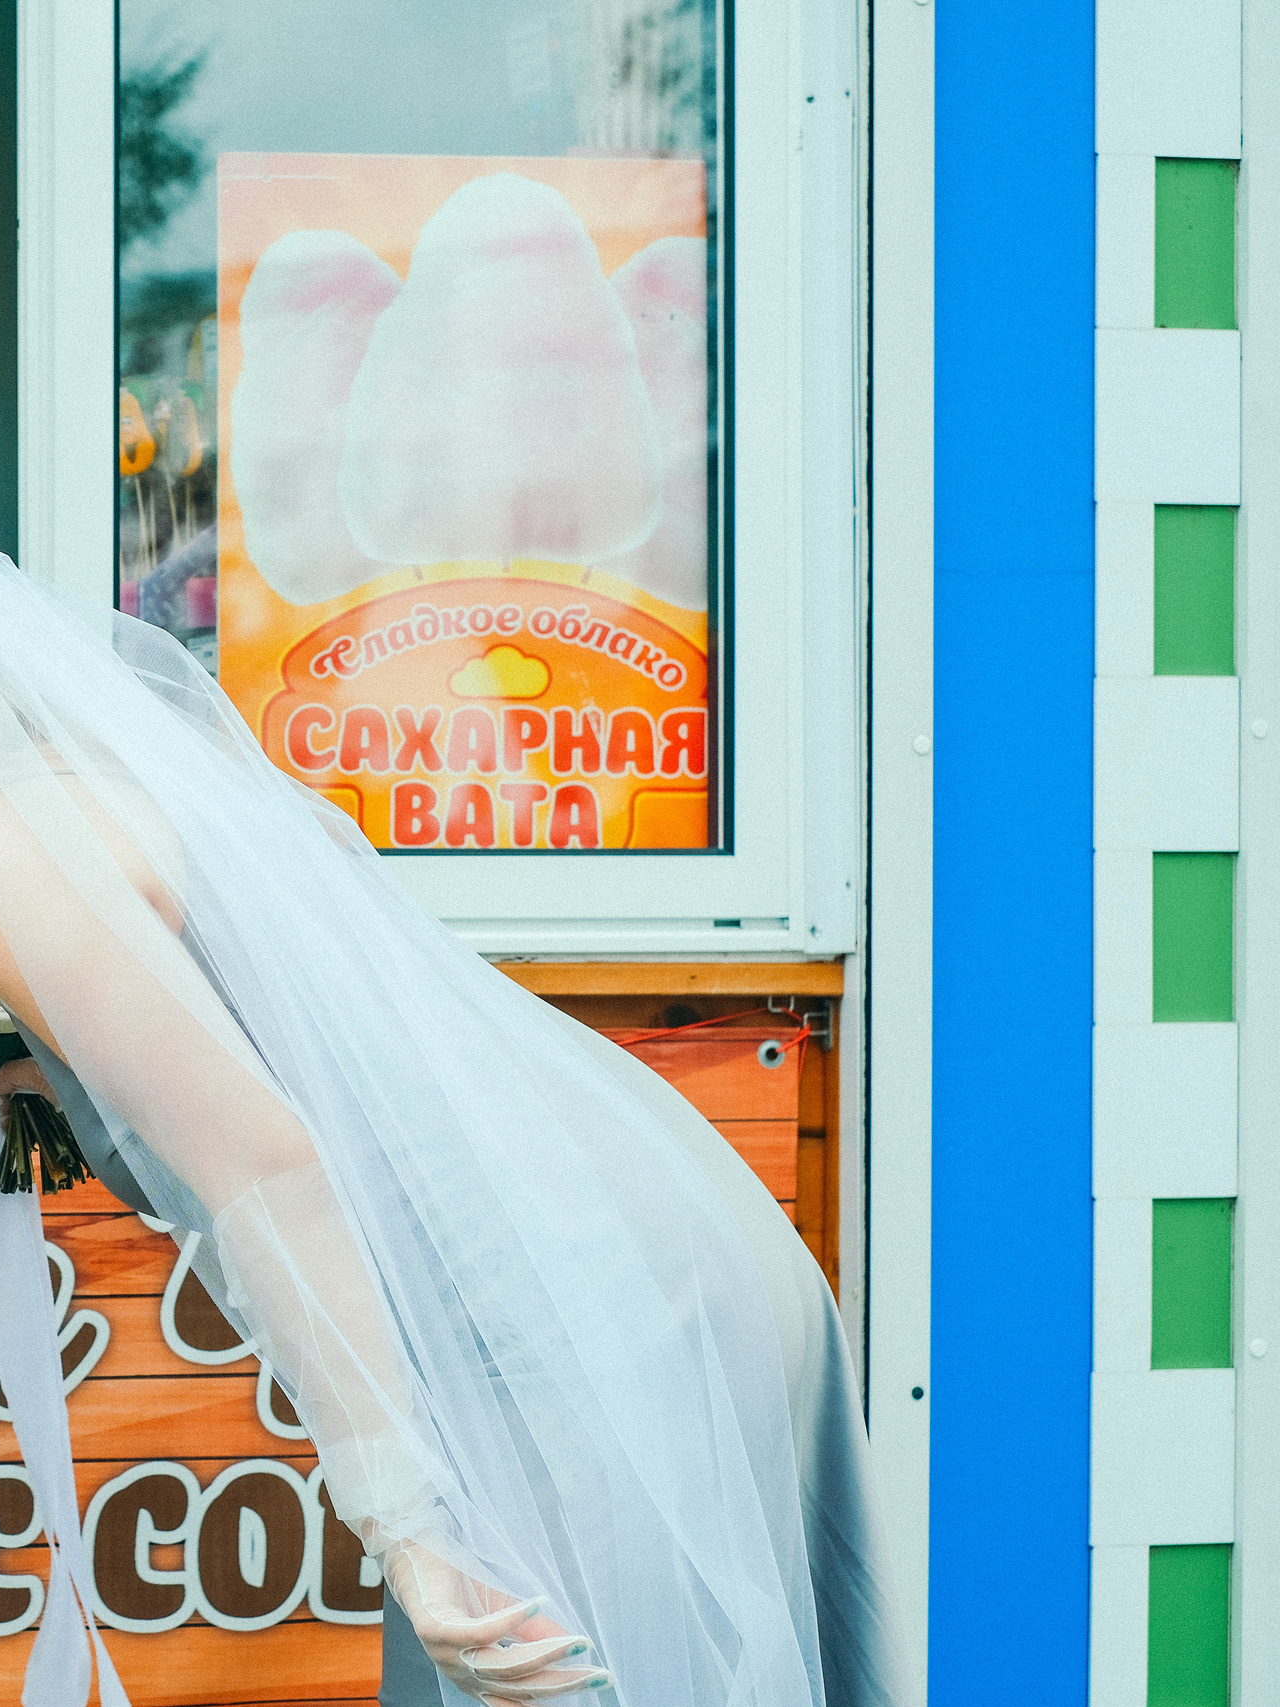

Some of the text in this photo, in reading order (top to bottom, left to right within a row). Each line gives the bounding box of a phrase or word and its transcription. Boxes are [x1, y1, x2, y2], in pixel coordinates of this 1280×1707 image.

[310, 604, 688, 692] Сладкое облако
[284, 702, 709, 779] САХАРНАЯ
[389, 781, 604, 849] ВАТА
